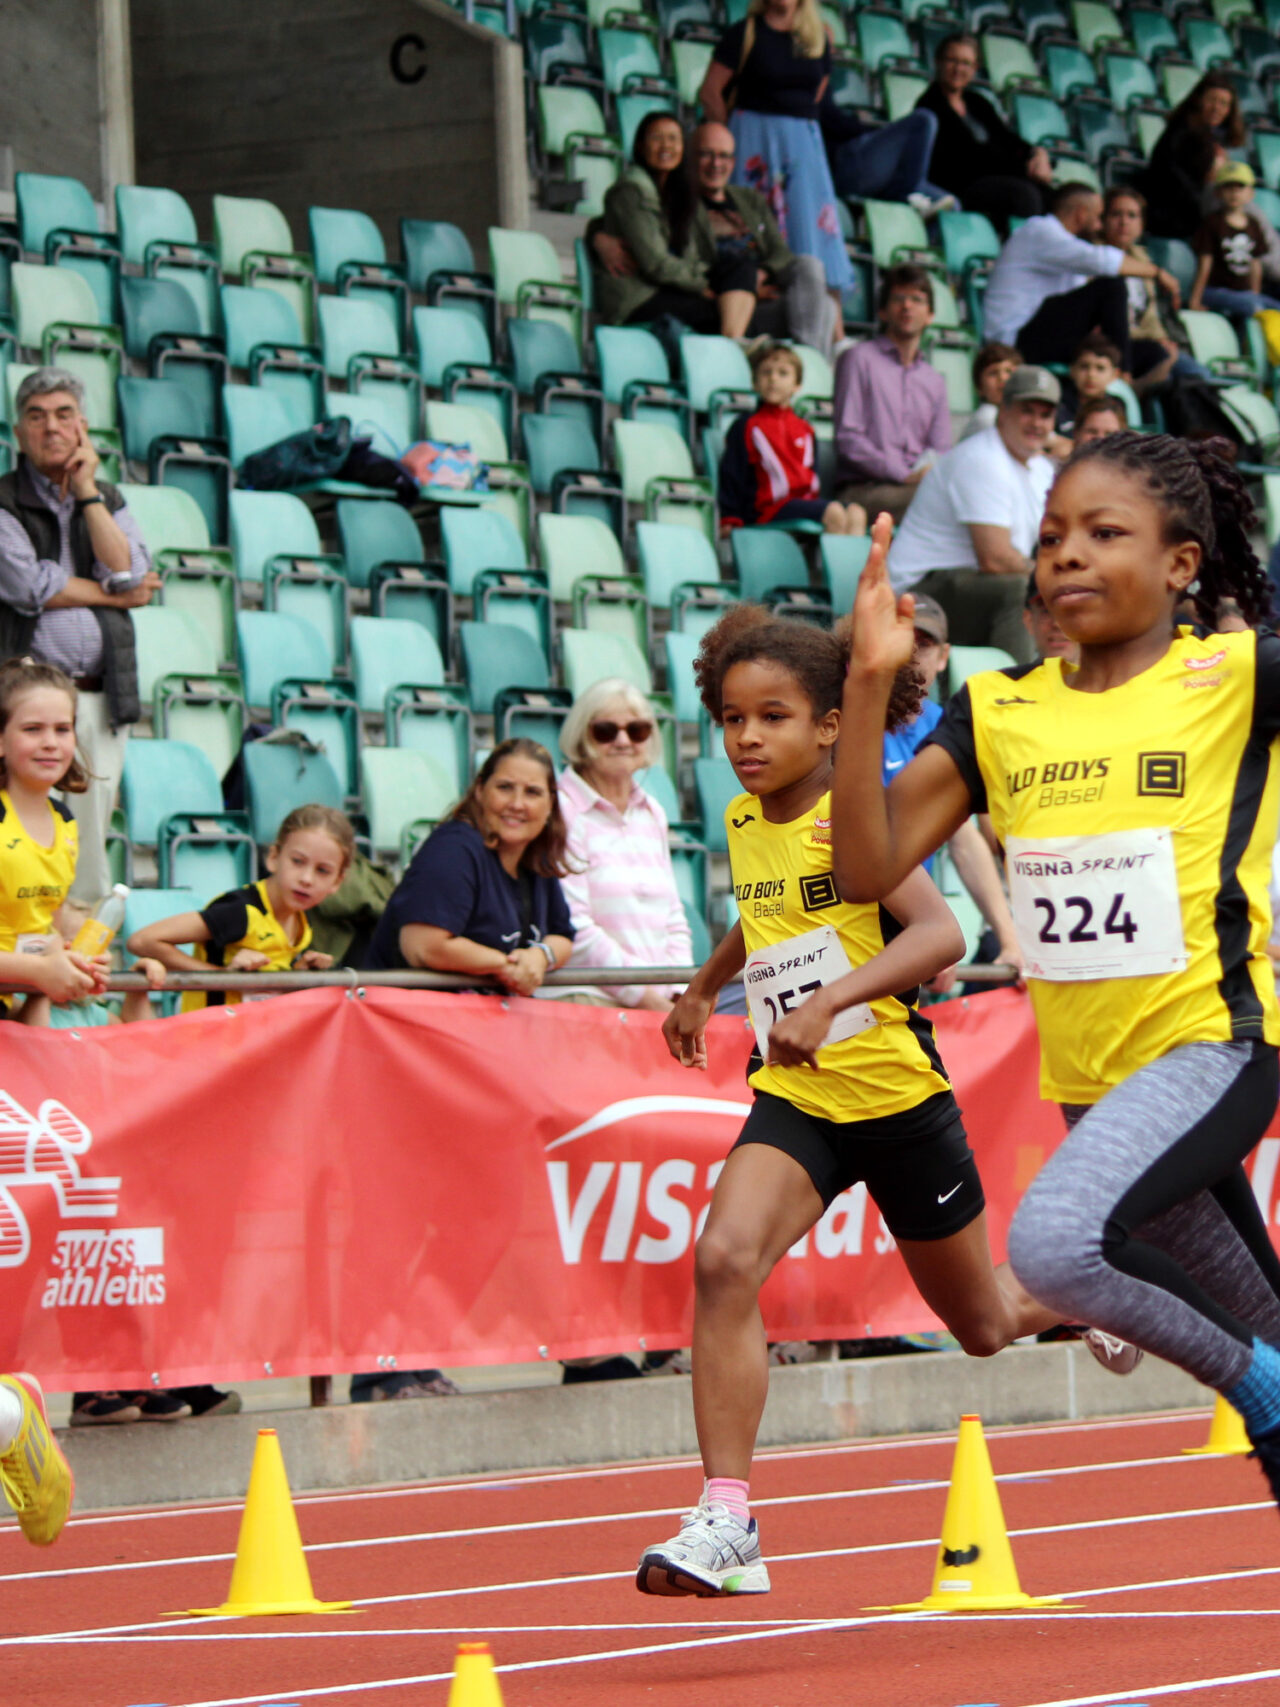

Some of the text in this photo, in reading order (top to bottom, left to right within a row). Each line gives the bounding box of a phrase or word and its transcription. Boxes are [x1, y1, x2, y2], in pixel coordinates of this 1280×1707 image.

[390, 33, 427, 85] C
[1041, 757, 1112, 784] BOYS
[1038, 780, 1105, 808] Basel
[1075, 852, 1156, 875] SPRINT
[753, 879, 786, 899] BOYS
[753, 898, 785, 918] Basel
[1033, 892, 1139, 944] 224
[777, 946, 829, 976] SPRINT
[53, 1232, 136, 1268] swiss
[40, 1265, 166, 1309] athletics
